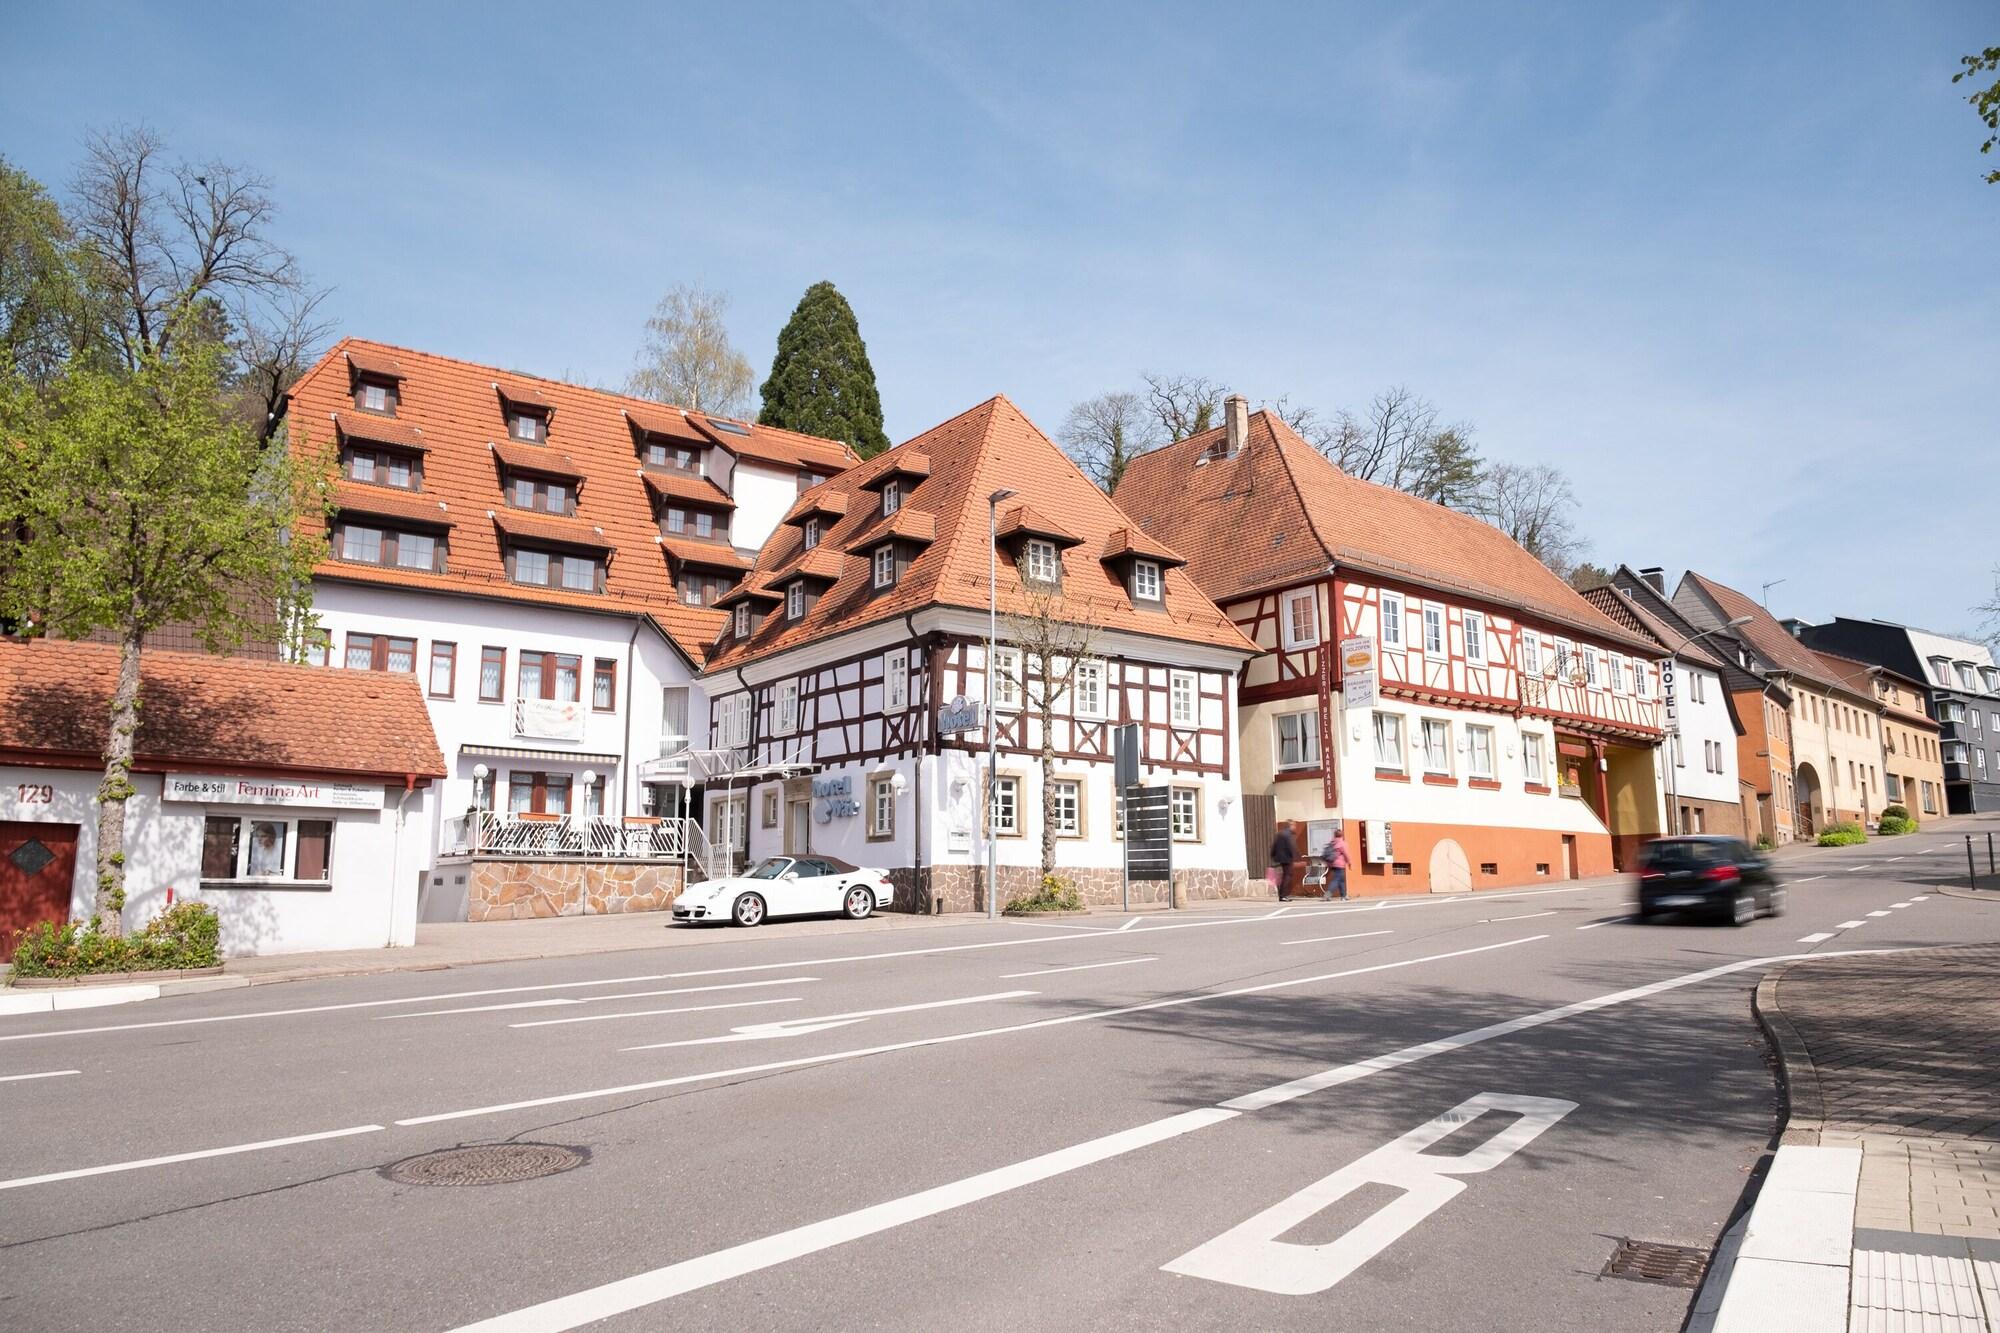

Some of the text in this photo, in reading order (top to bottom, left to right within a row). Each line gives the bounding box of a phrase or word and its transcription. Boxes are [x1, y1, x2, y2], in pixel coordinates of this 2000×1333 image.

[1662, 661, 1675, 719] HOTEL
[18, 784, 53, 804] 129
[174, 782, 226, 793] Farbe & Stil
[238, 781, 320, 799] Femina Art
